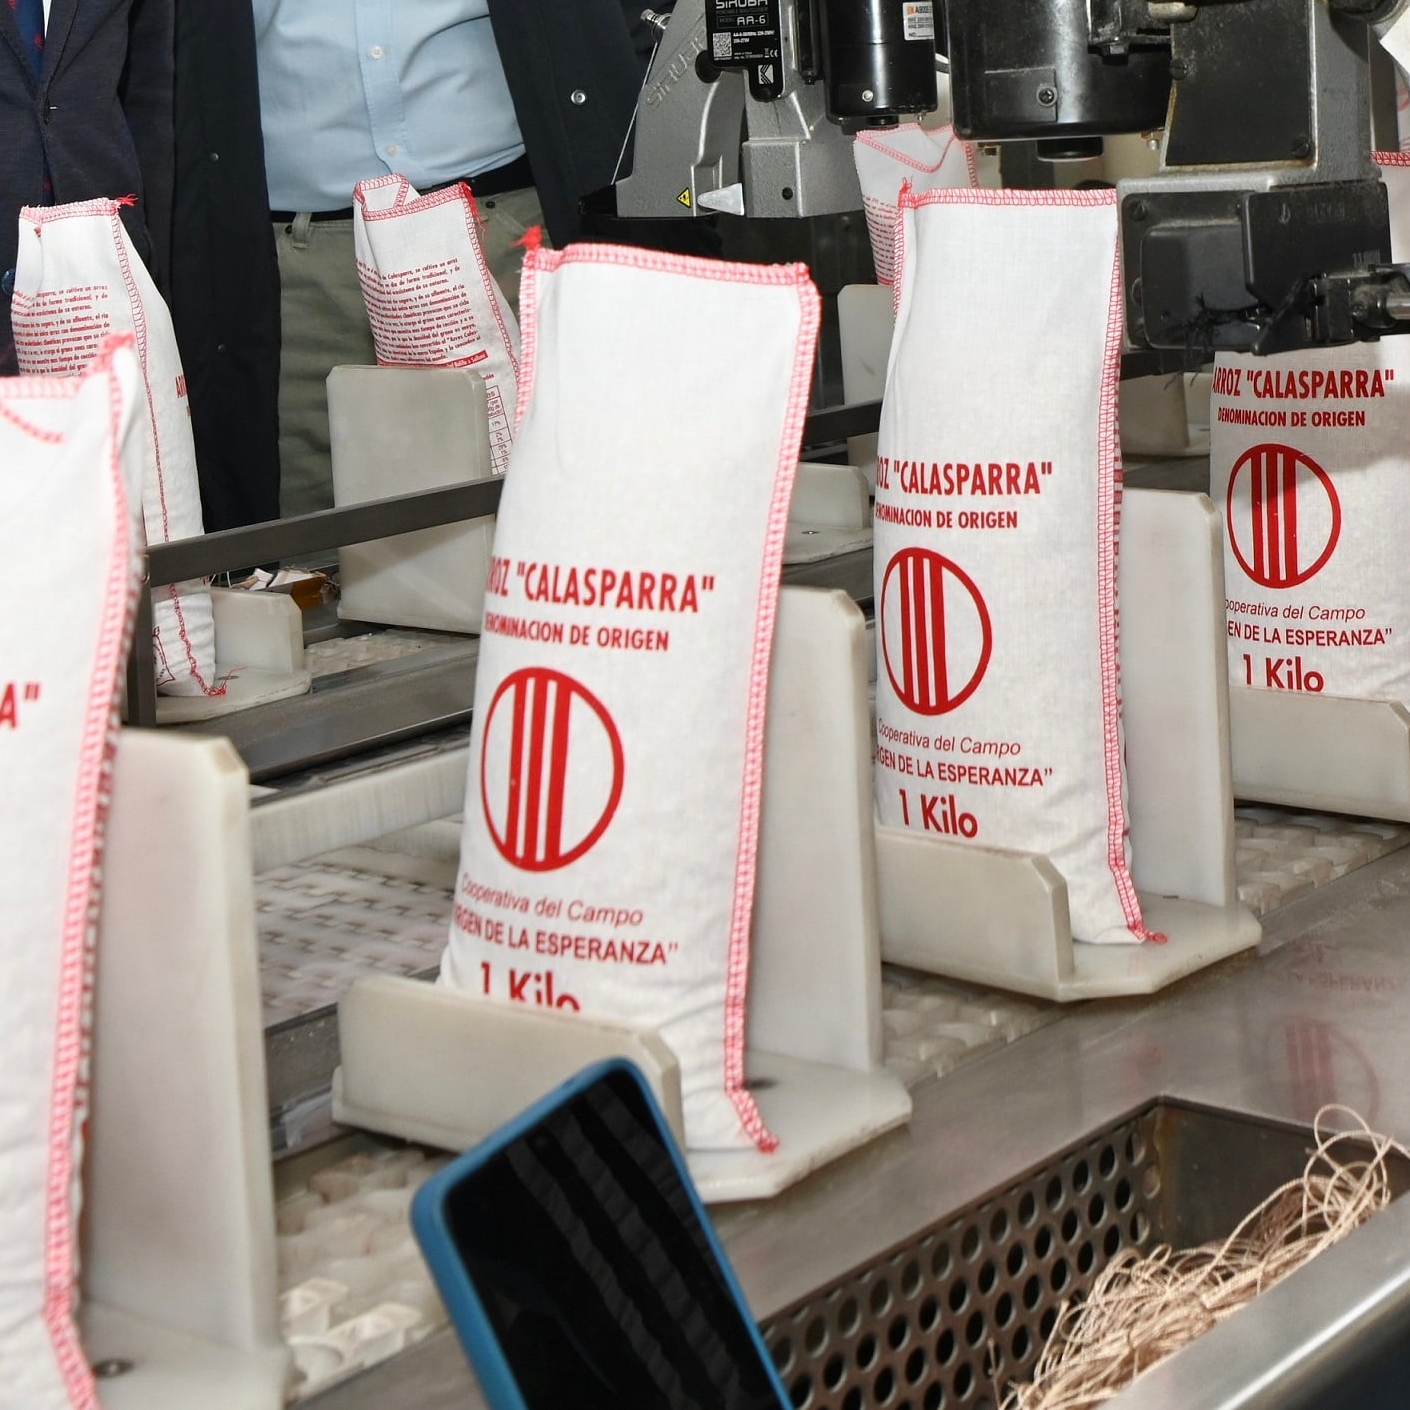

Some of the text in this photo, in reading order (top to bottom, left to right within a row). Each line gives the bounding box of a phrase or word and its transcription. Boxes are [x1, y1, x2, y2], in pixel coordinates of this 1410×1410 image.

[736, 15, 766, 26] AA-6
[1213, 367, 1394, 399] ARROZ "CALASPARRA"
[1218, 407, 1365, 427] DENOMINACION DE ORIGEN
[894, 460, 1052, 496] "CALASPARRA"
[936, 511, 953, 528] DE
[957, 510, 1018, 529] ORIGEN
[516, 560, 715, 612] "CALASPARRA"
[1283, 605, 1304, 619] del
[1308, 605, 1366, 623] Campo
[569, 625, 590, 646] DE
[597, 627, 669, 651] ORIGEN
[1244, 624, 1260, 642] DE
[1264, 627, 1281, 644] LA
[1243, 653, 1324, 693] 1 Kilo
[878, 718, 1022, 759] Cooperativa del Campo
[898, 753, 913, 775] DE
[917, 759, 934, 779] LA
[899, 788, 979, 838] 1 Kilo
[534, 896, 563, 918] del
[567, 899, 644, 928] Campo
[484, 915, 503, 946] DE
[508, 925, 530, 950] LA
[481, 960, 490, 995] 1
